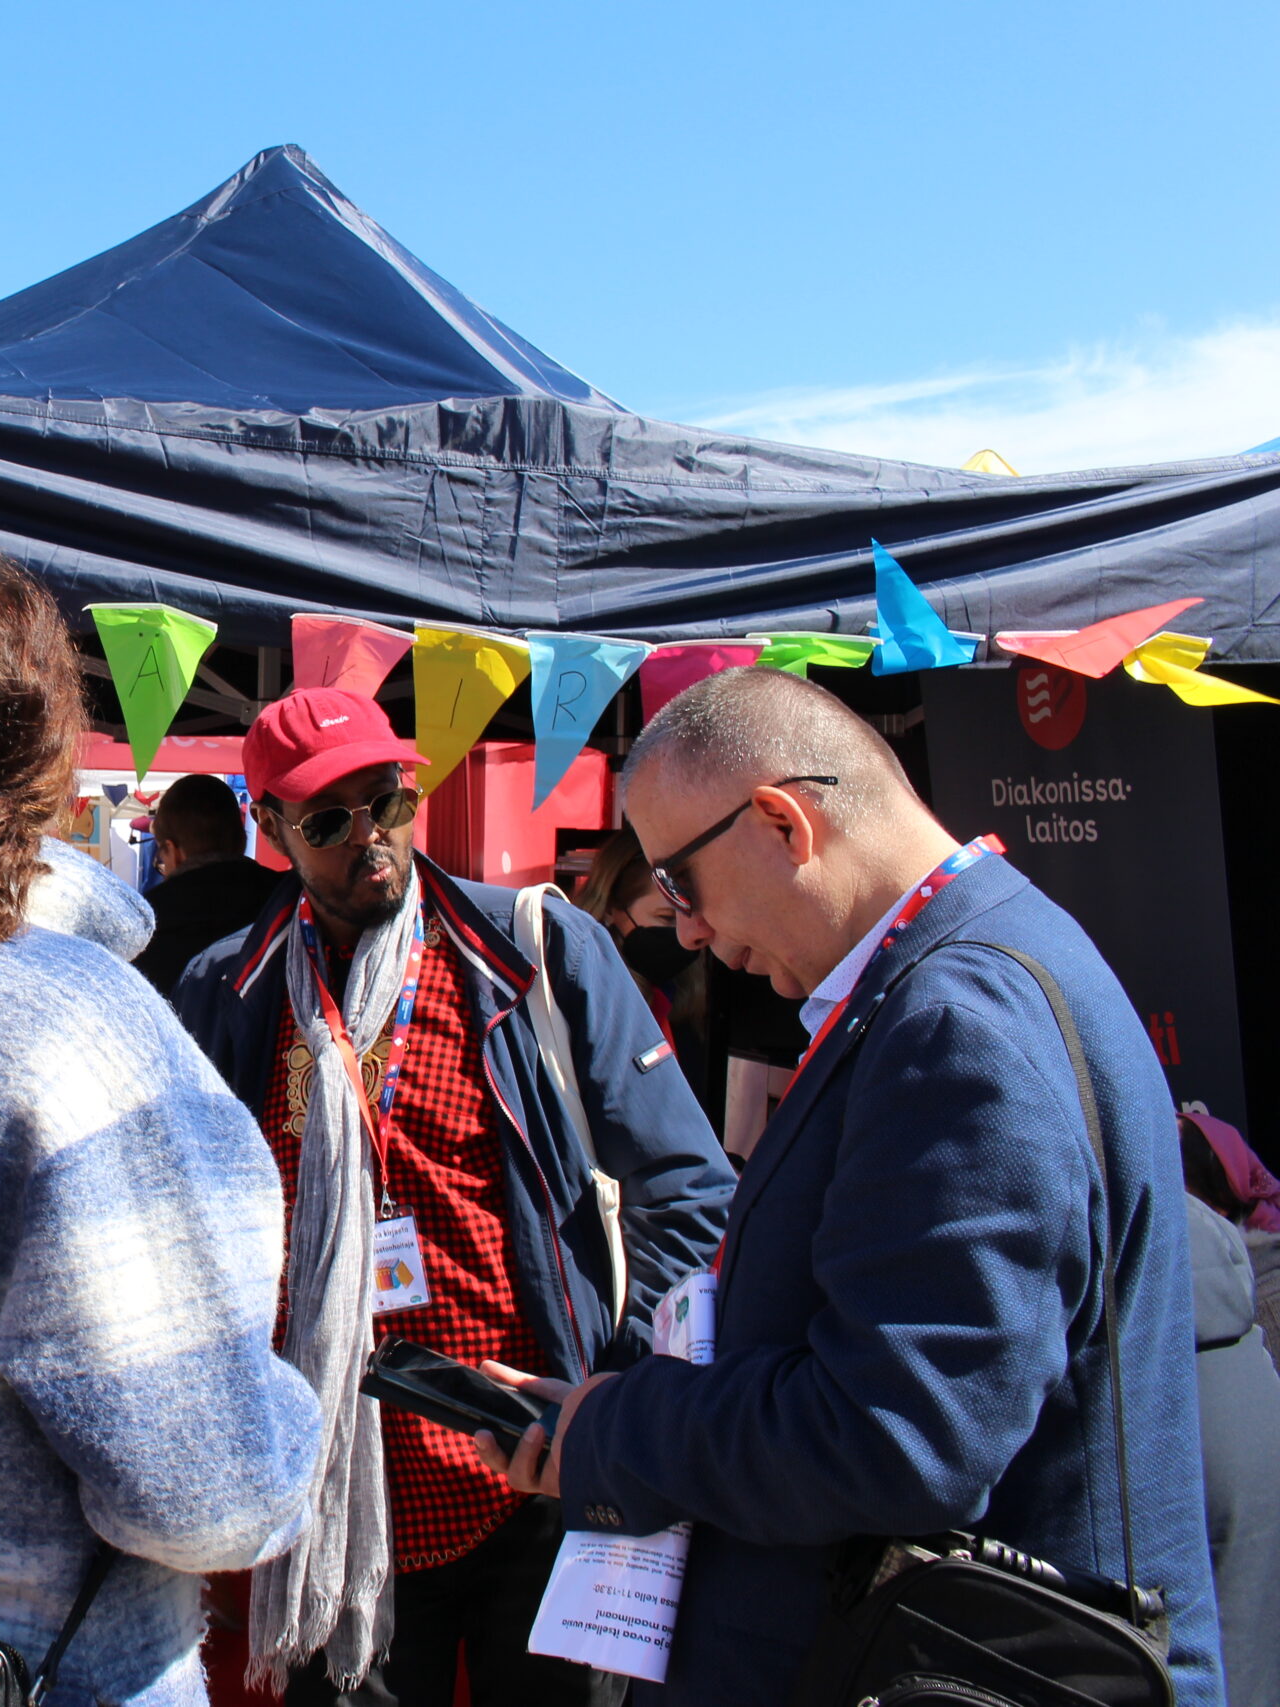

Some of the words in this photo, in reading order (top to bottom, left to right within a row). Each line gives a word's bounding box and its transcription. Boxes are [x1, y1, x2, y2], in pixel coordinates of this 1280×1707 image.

[551, 670, 587, 731] R
[1025, 812, 1099, 844] laitos
[634, 1591, 658, 1605] kello
[561, 1619, 583, 1629] uusia
[595, 1609, 660, 1630] maailmaan!
[584, 1622, 621, 1639] itsellesi
[622, 1630, 652, 1643] avaa
[653, 1639, 663, 1650] ja
